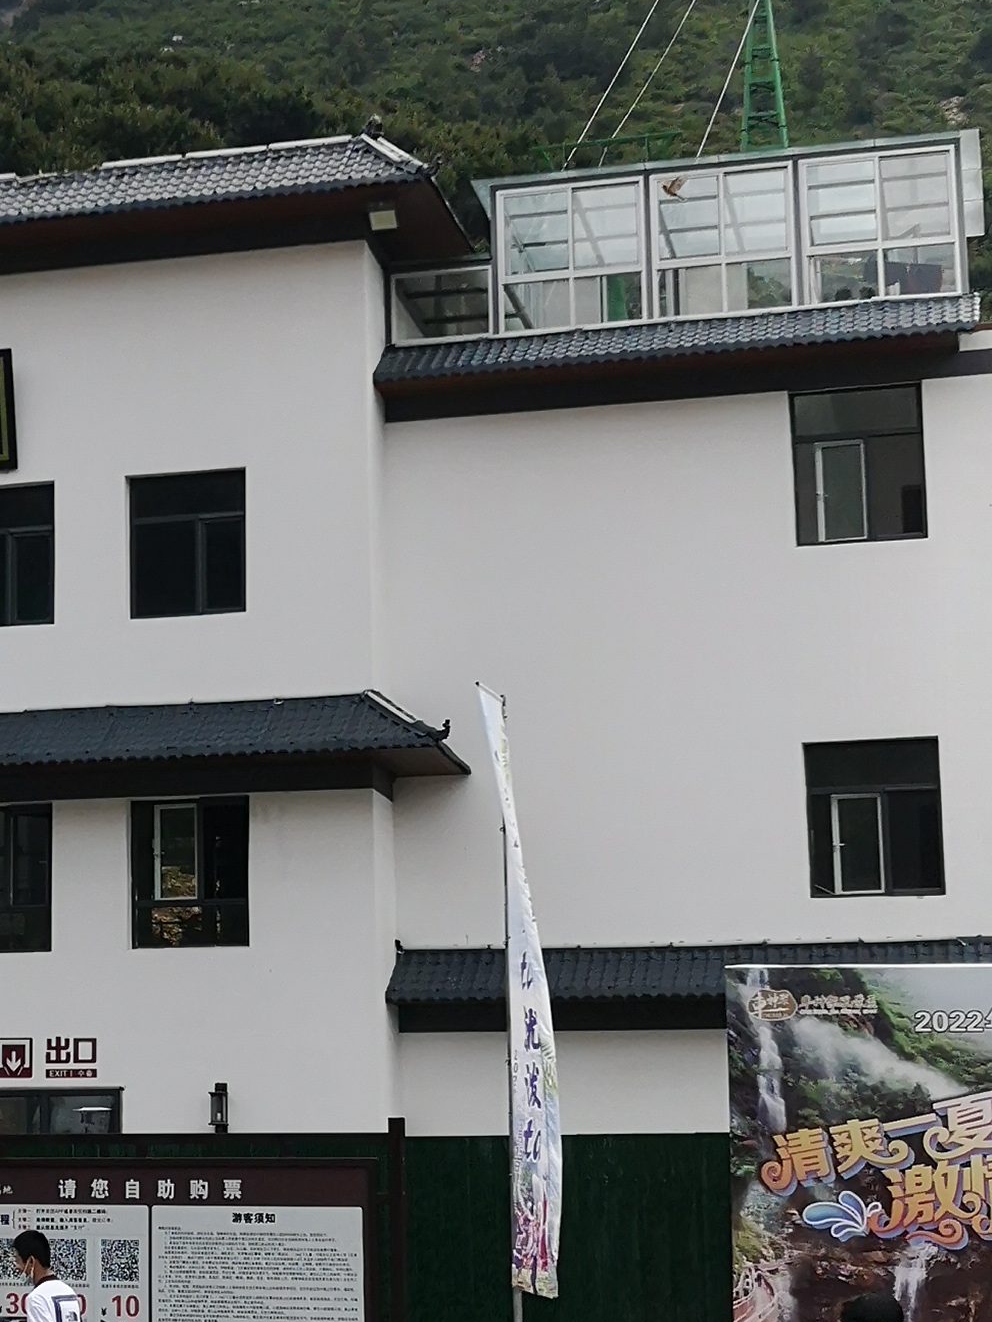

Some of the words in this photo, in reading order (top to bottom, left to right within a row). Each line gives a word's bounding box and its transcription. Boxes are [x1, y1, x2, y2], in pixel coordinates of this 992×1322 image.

[46, 1036, 97, 1064] 出口
[760, 1090, 992, 1193] 清爽一夏
[58, 1178, 243, 1200] 请您自助购票
[231, 1212, 277, 1224] 游客须知
[111, 1294, 140, 1317] 10
